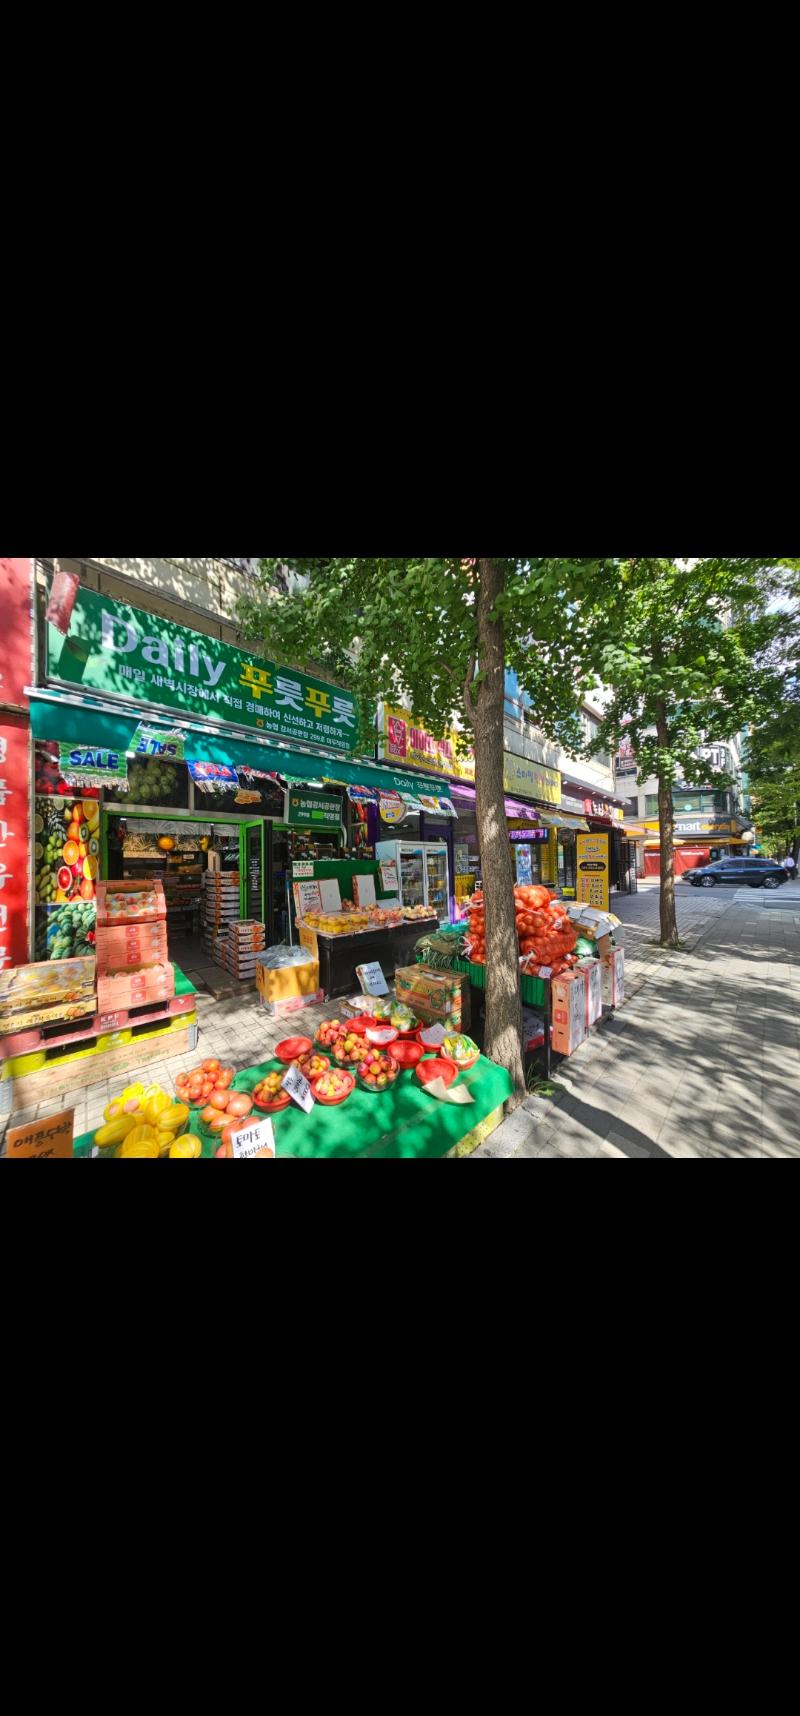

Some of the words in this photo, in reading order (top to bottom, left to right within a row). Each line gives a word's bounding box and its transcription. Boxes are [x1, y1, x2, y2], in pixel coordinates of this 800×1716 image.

[101, 608, 226, 687] Daily
[119, 664, 146, 682] 매일
[151, 674, 220, 703] 새벽시장에서
[223, 694, 243, 709] 직접
[246, 701, 281, 720] 경매하여
[283, 712, 314, 729] 신선하고
[266, 721, 279, 732] 농협
[69, 751, 119, 769] SALE
[393, 777, 414, 790] Daily
[674, 822, 701, 831] mart
